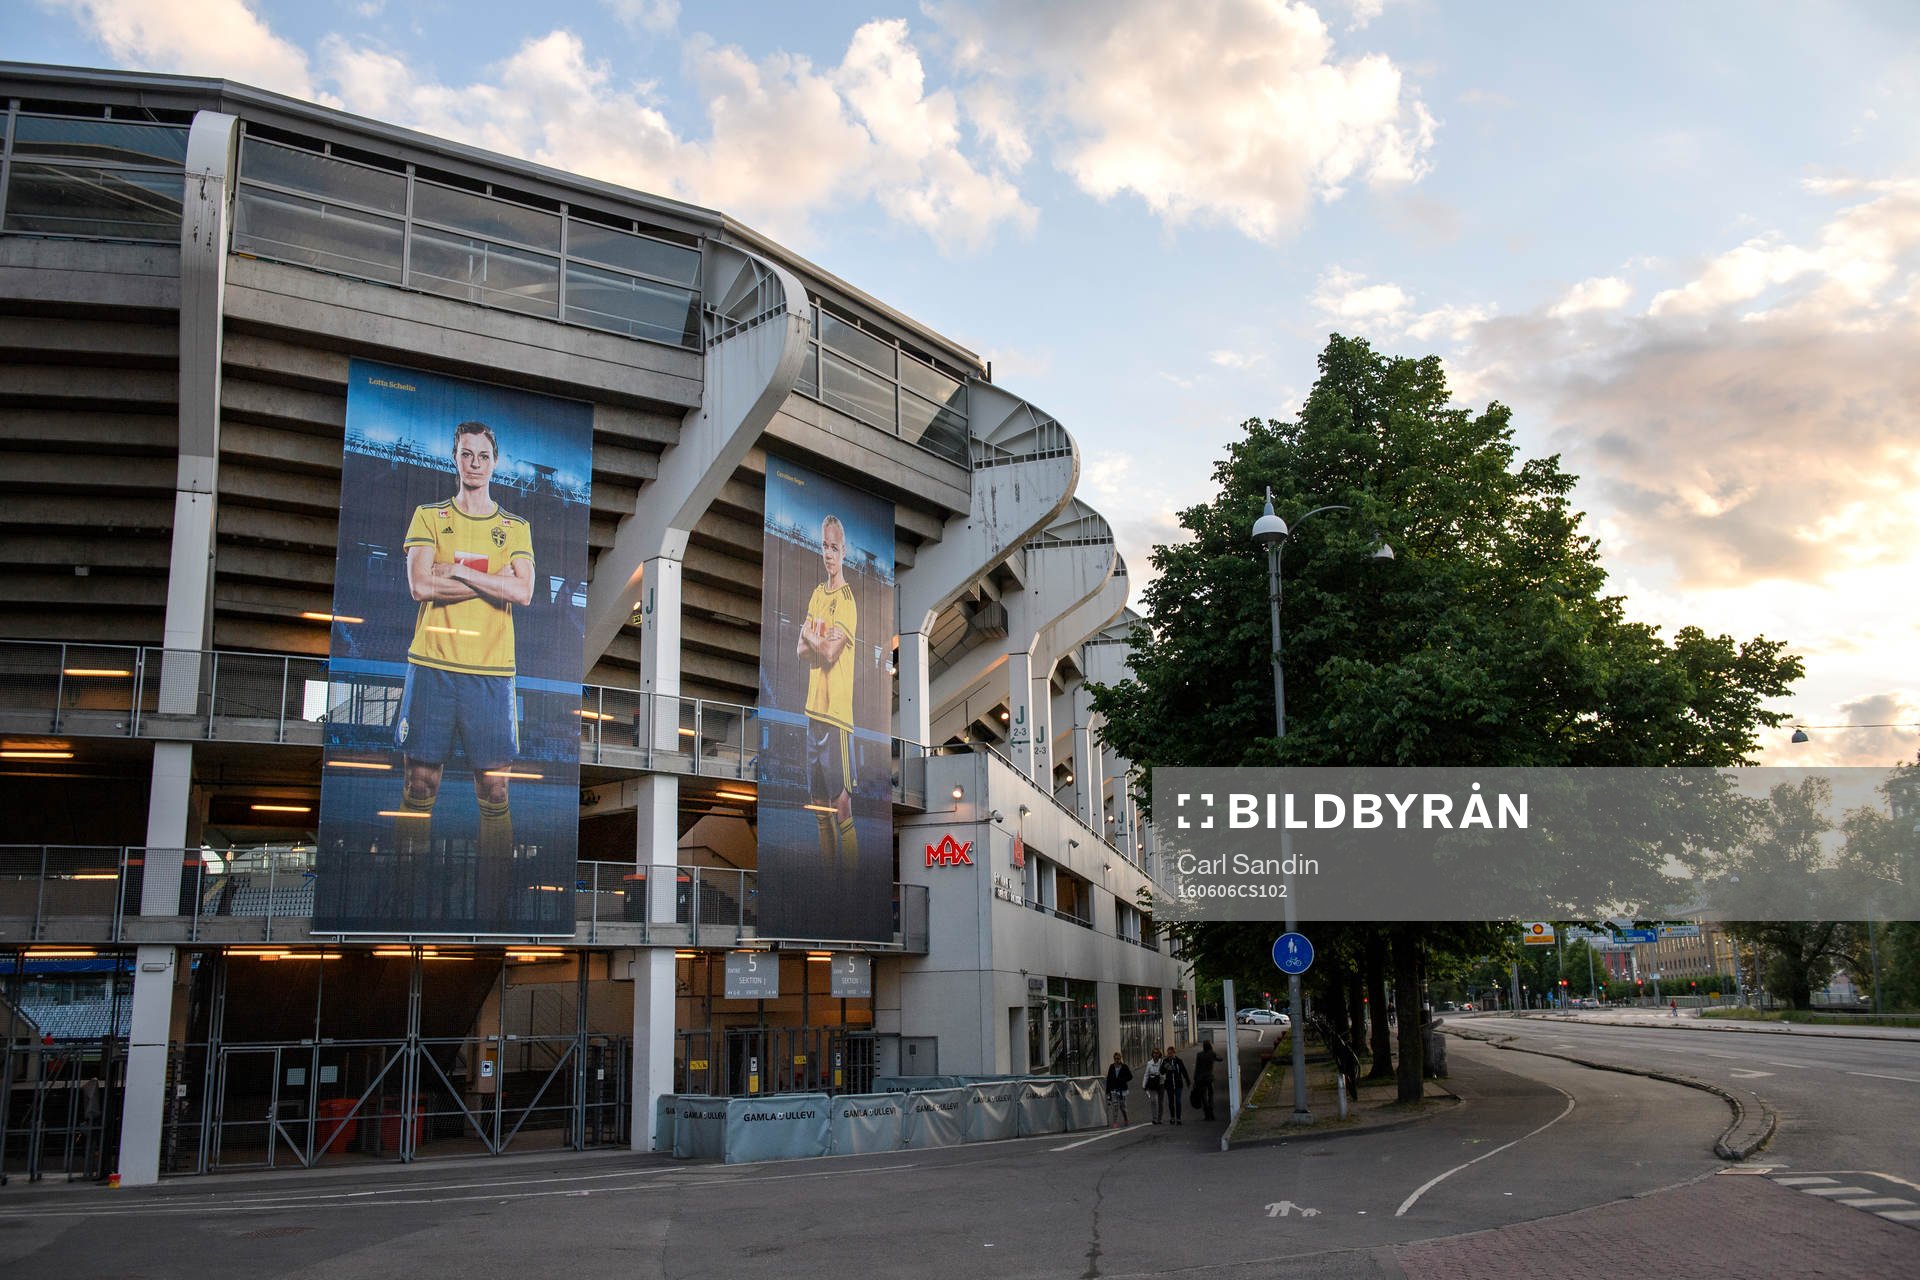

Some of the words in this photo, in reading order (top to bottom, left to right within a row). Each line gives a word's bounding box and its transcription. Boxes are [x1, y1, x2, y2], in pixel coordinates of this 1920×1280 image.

[645, 587, 654, 614] J
[1015, 705, 1024, 724] J
[1013, 728, 1027, 737] 2-3
[1036, 726, 1044, 744] J
[1034, 746, 1047, 755] 2-3
[925, 833, 973, 867] MAX
[748, 953, 757, 972] 5
[848, 956, 855, 973] 5
[684, 1111, 702, 1120] GAMLA
[743, 1112, 777, 1122] GAMLA
[785, 1110, 816, 1120] ULLEVI
[843, 1109, 868, 1118] GAMLA
[874, 1106, 897, 1116] ULLEVI
